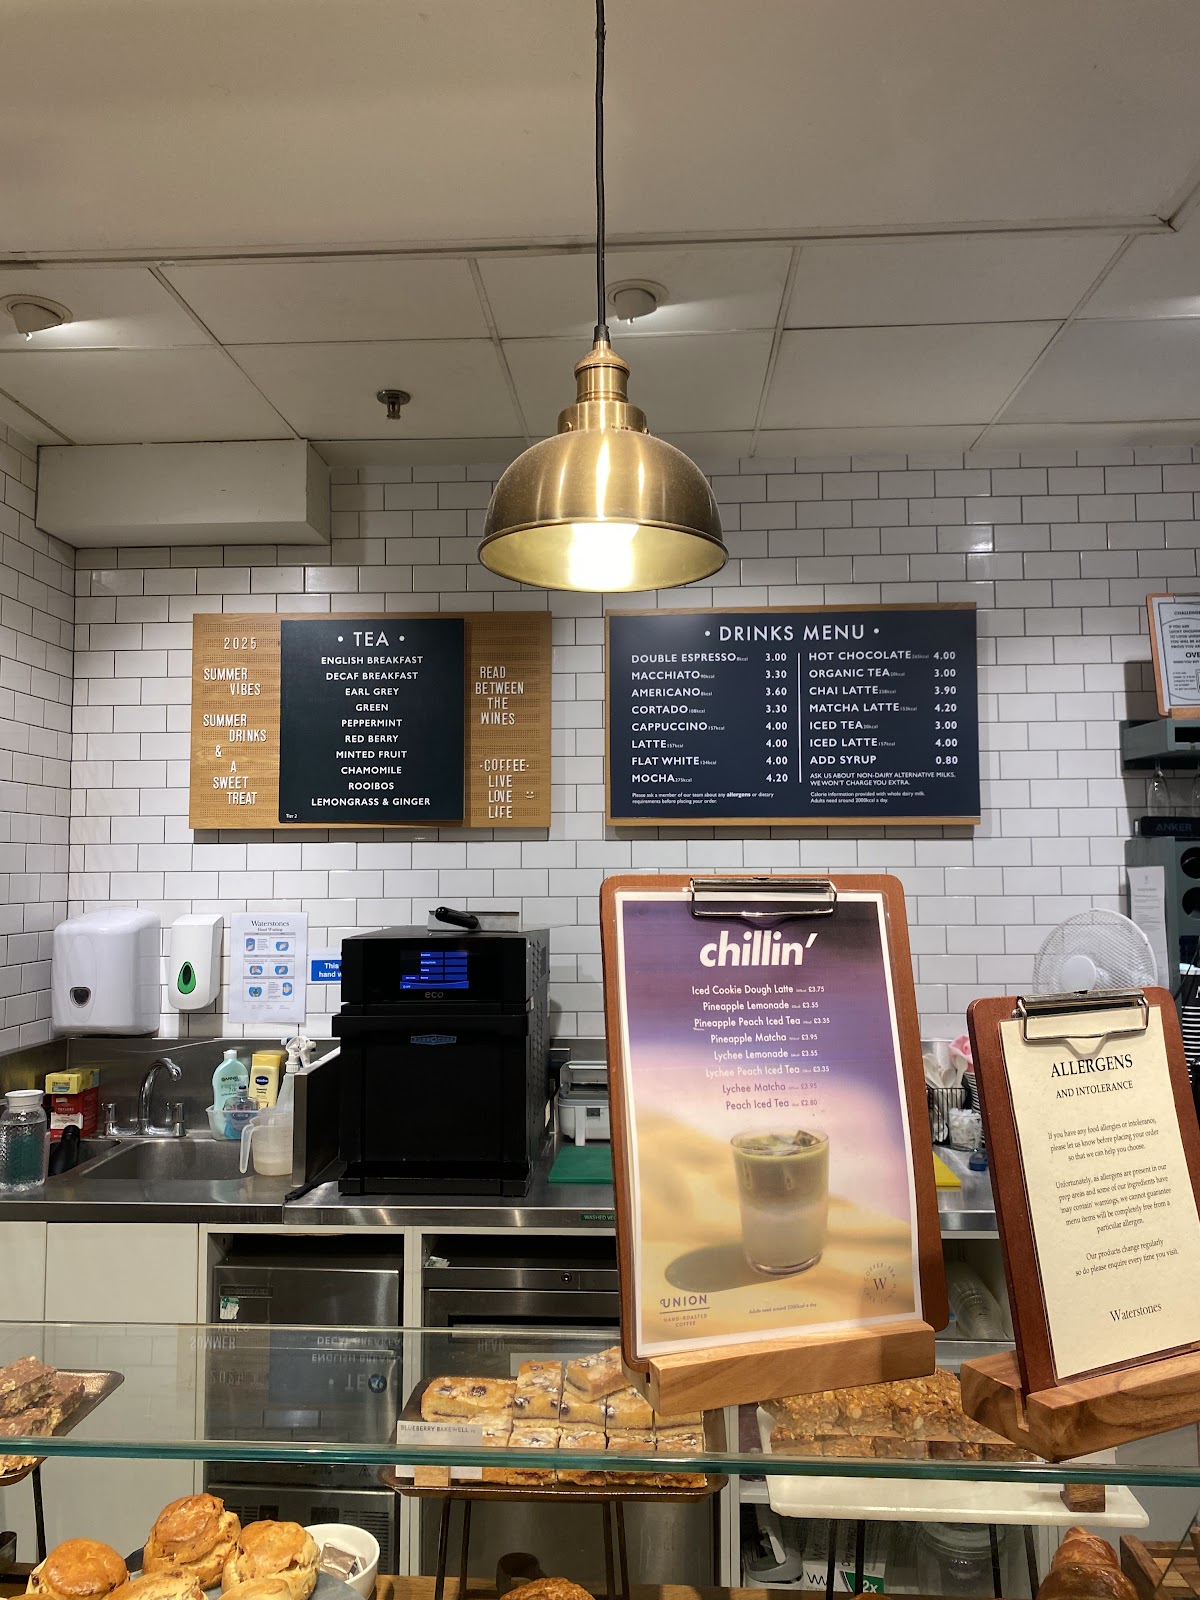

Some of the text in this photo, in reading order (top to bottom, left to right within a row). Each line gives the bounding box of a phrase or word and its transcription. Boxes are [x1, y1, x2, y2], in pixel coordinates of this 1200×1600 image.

[353, 631, 389, 646] TEA
[720, 624, 864, 641] DRINKS MENU
[224, 637, 256, 649] 2025
[367, 656, 423, 664] BREAKFAST
[632, 653, 786, 663] DOUBLE ESPRESSO 3.00
[809, 650, 956, 661] HOT CHOCOLATE 4.00
[204, 668, 247, 680] SUMMER
[362, 672, 418, 680] BREAKFAST
[480, 666, 506, 678] READ
[632, 670, 787, 680] MACCHIATO 3.30
[809, 668, 956, 678] ORGANIC TEA 3.00
[230, 683, 260, 695] VIBES
[476, 682, 524, 694] BETWEEN
[632, 687, 787, 697] AMERICANO 3.60
[809, 686, 956, 695] CHAI LATTE 3.90
[487, 697, 508, 710] THE
[632, 704, 787, 714] CORTADO 3.30
[810, 703, 957, 712] MATCHA LATTE 4.20
[203, 714, 246, 726] SUMMER
[342, 719, 402, 727] PEPPERMINT
[481, 712, 514, 725] WINES
[632, 722, 787, 731] CAPPUCCINO 4.00
[810, 721, 957, 730] ICED TEA 3.00
[230, 729, 266, 742] DRINKS
[632, 739, 787, 748] LATTE 4.00
[810, 738, 958, 747] ICED LATTE 4.00
[215, 745, 222, 757] &
[484, 758, 526, 771] COFFEE
[632, 756, 788, 765] FLAT WHITE 4.00
[810, 755, 958, 764] ADD SYRUP 0.80
[230, 760, 236, 772] A
[213, 776, 249, 789] SWEET
[489, 775, 512, 787] LIVE
[632, 774, 788, 782] MOCHA 4.20
[348, 782, 394, 790] ROOIBOS
[226, 792, 257, 804] TREAT
[312, 798, 379, 806] LEMONGRASS
[488, 790, 512, 802] LOVE
[489, 805, 512, 818] LIFE
[1156, 823, 1192, 832] ANKER
[700, 930, 818, 967] chillin'
[692, 985, 710, 995] Iced
[712, 984, 742, 994] Cookie
[744, 984, 772, 996] Dough
[774, 984, 793, 993] Latte
[703, 1000, 744, 1012] Pineapple
[747, 999, 789, 1010] Lemonade
[694, 1017, 736, 1028] Pineapple
[738, 1016, 764, 1026] Peach
[766, 1015, 784, 1025] Iced
[785, 1016, 800, 1024] Tea
[711, 1033, 752, 1045] Pineapple
[756, 1032, 786, 1042] Matcha
[714, 1050, 742, 1062] Lychee
[746, 1048, 788, 1058] Lemonade
[706, 1067, 734, 1079] Lychee
[737, 1065, 762, 1075] Peach
[765, 1064, 782, 1074] Iced
[784, 1064, 800, 1074] Tea
[1051, 1054, 1132, 1078] ALLERGENS
[722, 1083, 751, 1095] Lychee
[754, 1082, 786, 1092] Matcha
[1056, 1080, 1133, 1099] AND INTOLERANCE
[726, 1099, 751, 1110] Peach
[754, 1098, 772, 1108] Iced
[774, 1098, 789, 1107] Tea
[1086, 1238, 1163, 1260] Our products change regularly
[873, 1277, 887, 1291] W
[660, 1294, 707, 1308] UNION
[664, 1314, 708, 1322] HAND-ROASTED
[1110, 1304, 1162, 1321] Waterstones
